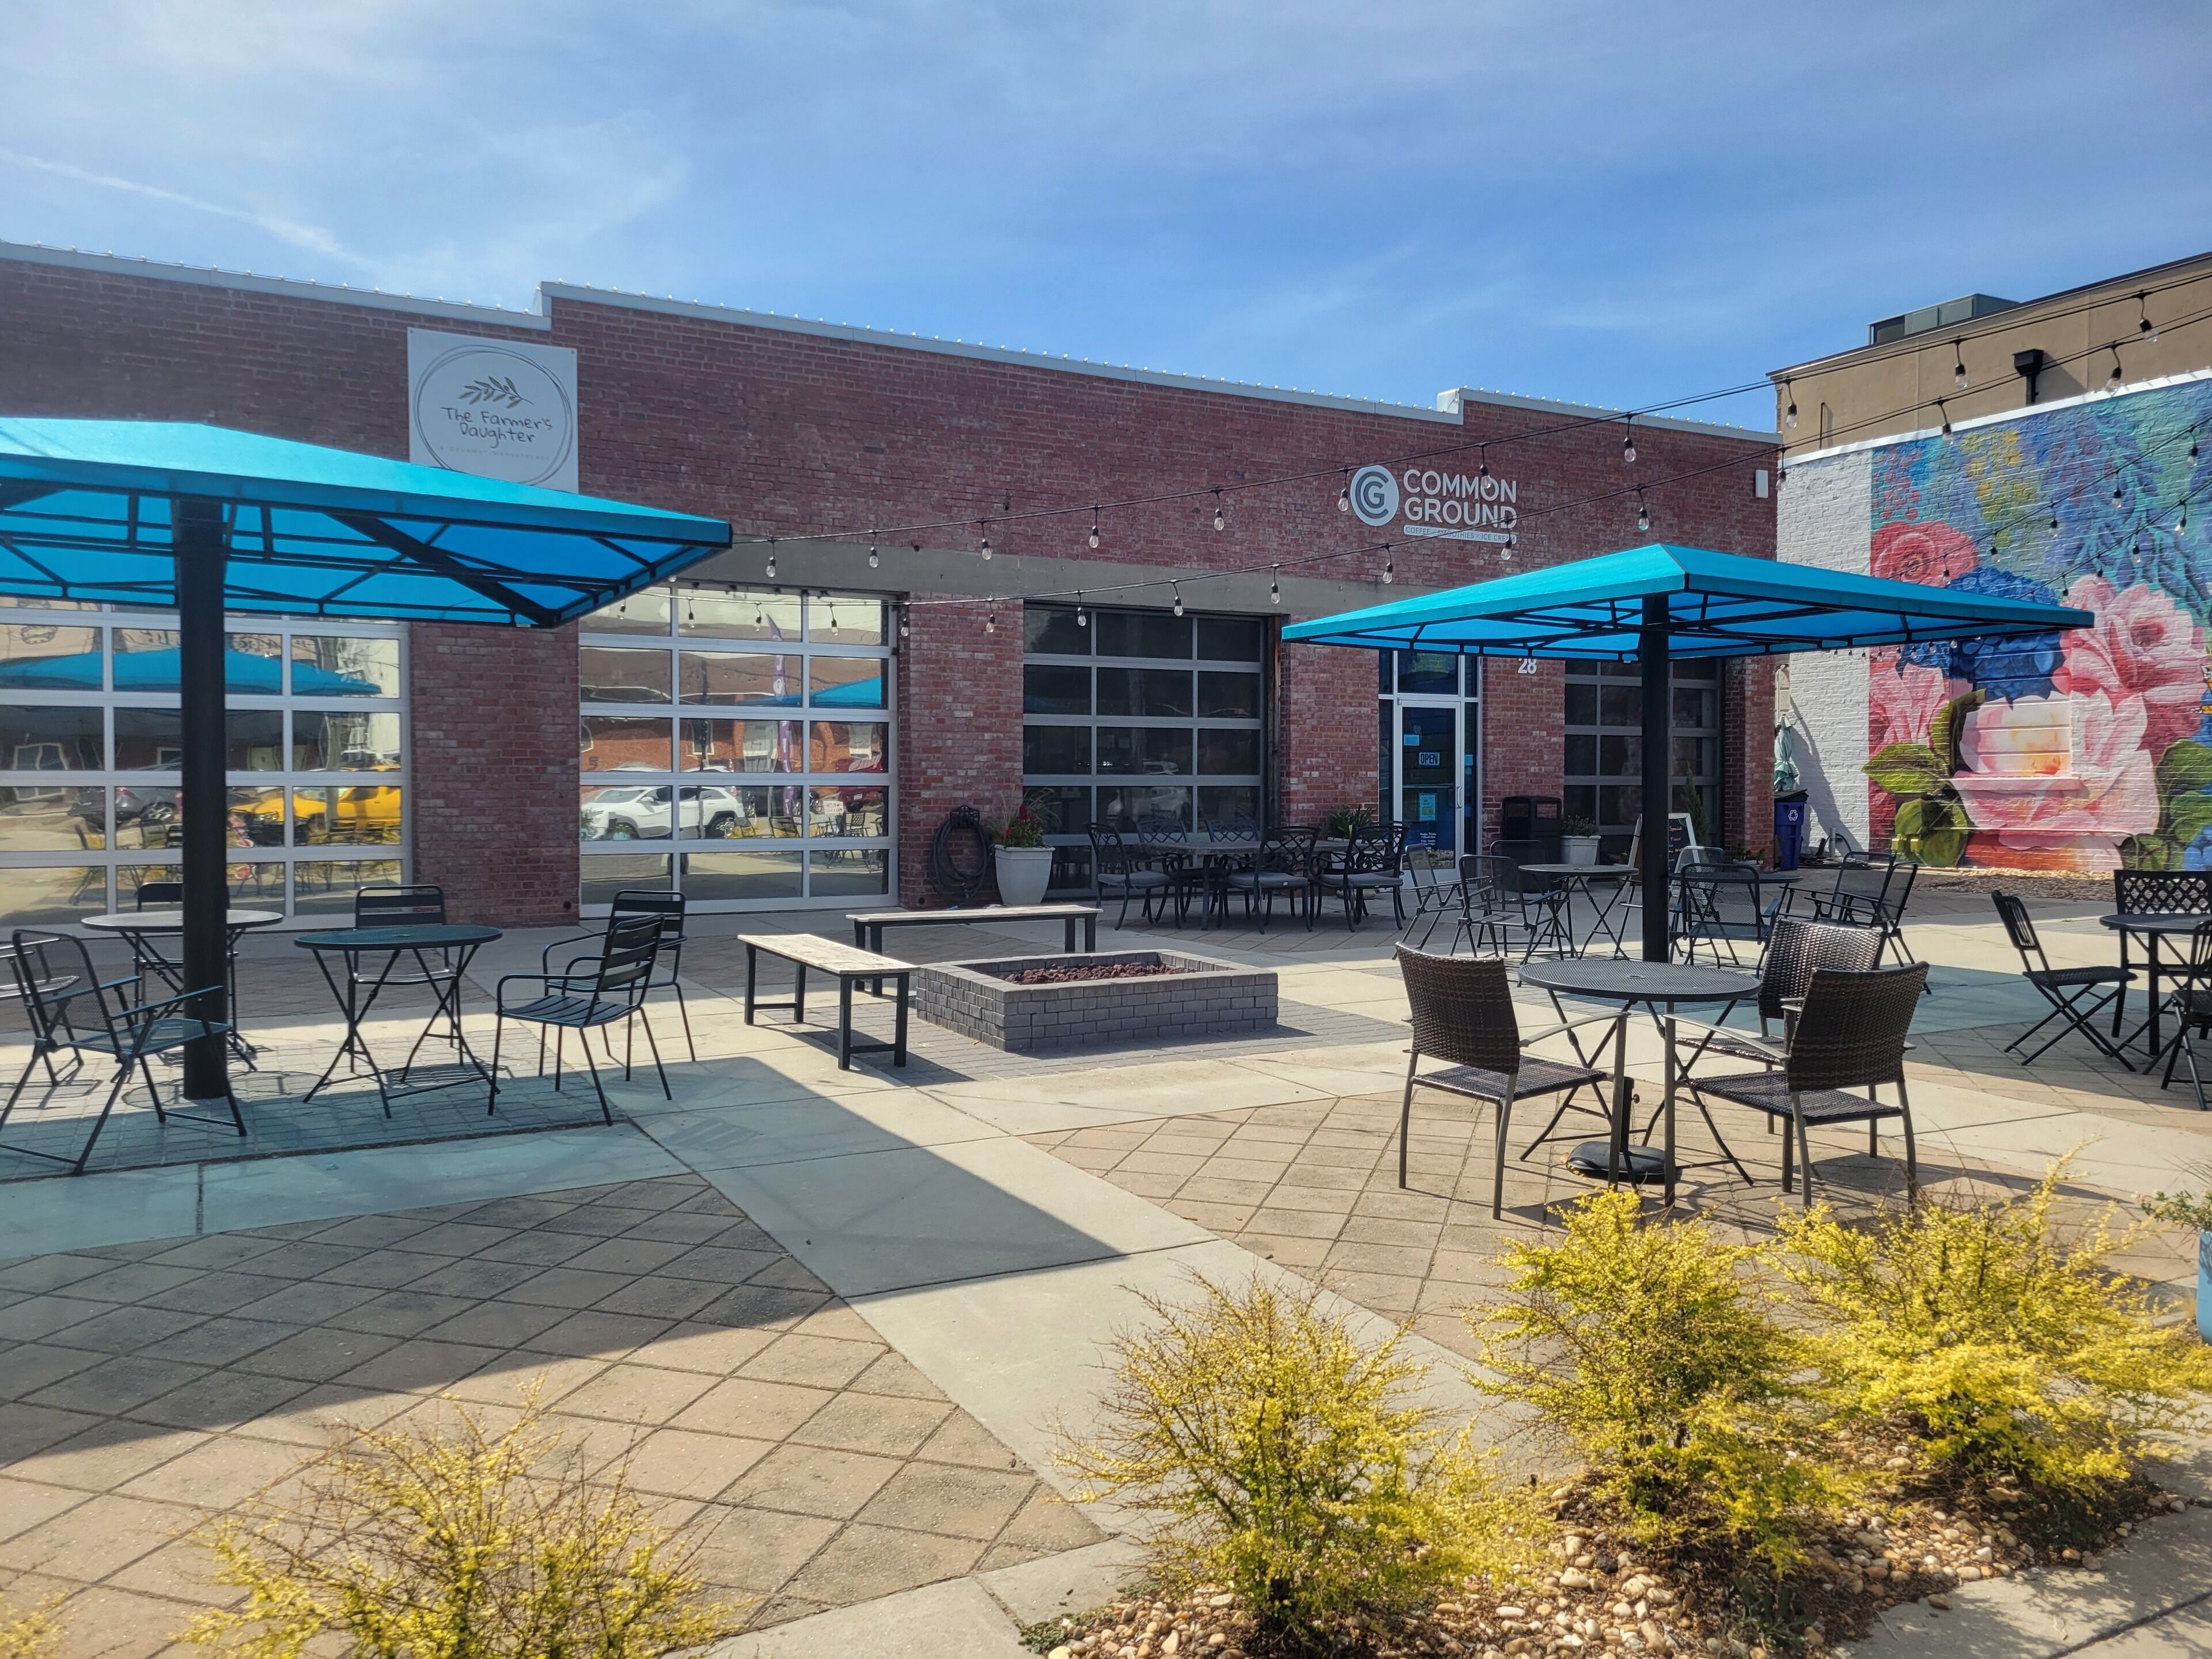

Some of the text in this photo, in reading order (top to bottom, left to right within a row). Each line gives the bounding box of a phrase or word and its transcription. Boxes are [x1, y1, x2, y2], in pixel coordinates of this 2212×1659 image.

[441, 407, 552, 430] The Farmer's
[459, 422, 535, 449] Daughter
[1403, 469, 1517, 504] COMMON
[1404, 497, 1517, 529] GROUND
[1406, 527, 1430, 535] COFFEE
[1517, 658, 1537, 674] 28
[1421, 753, 1438, 764] OPEN
